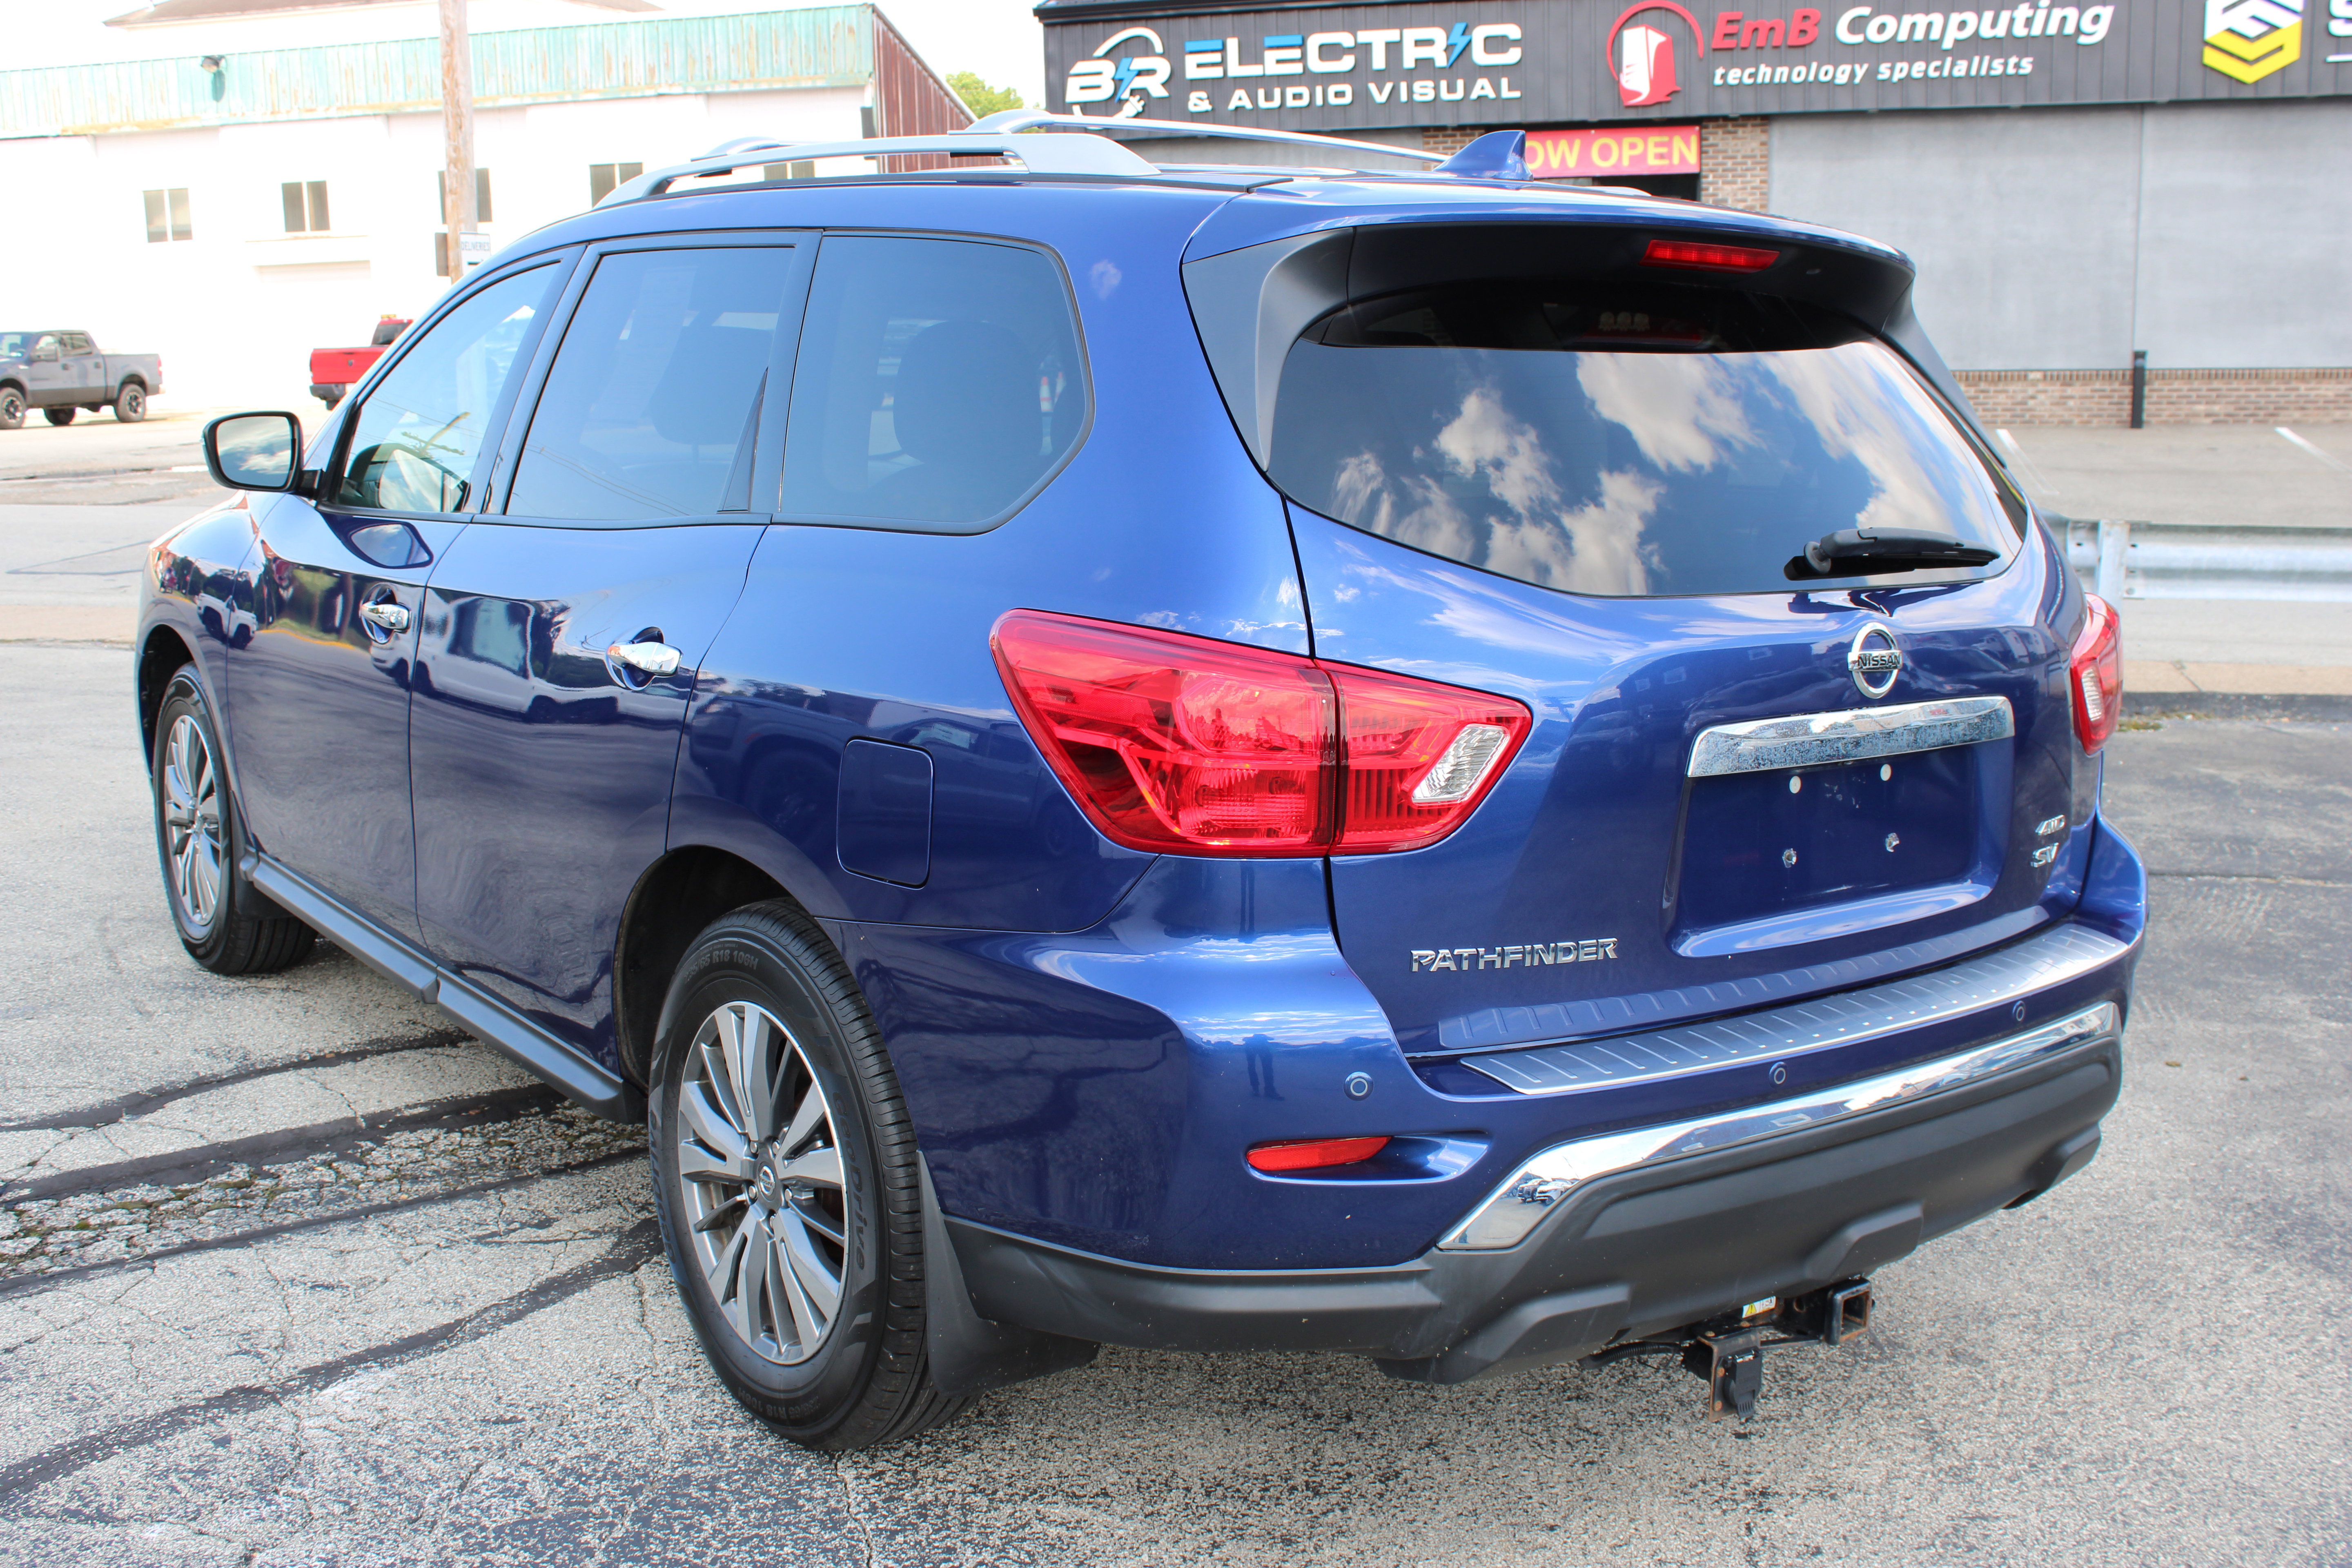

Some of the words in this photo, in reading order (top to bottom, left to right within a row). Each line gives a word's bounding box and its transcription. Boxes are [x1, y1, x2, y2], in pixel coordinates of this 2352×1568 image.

[1711, 8, 1822, 49] EmB
[1835, 0, 2115, 50] Computing
[1185, 22, 1522, 80] ELECTRIC
[1713, 61, 1869, 86] technology
[1876, 55, 2034, 83] specialists
[1187, 90, 1213, 113] &
[1227, 83, 1354, 111] AUDIO
[1368, 77, 1522, 104] VISUAL
[1526, 139, 1581, 170] OW
[1591, 134, 1697, 168] OPEN
[461, 241, 490, 251] DELIVERIES
[1858, 655, 1901, 667] NISSAN
[1410, 938, 1618, 972] PATHFINDER
[833, 1091, 868, 1271] GeoDrive
